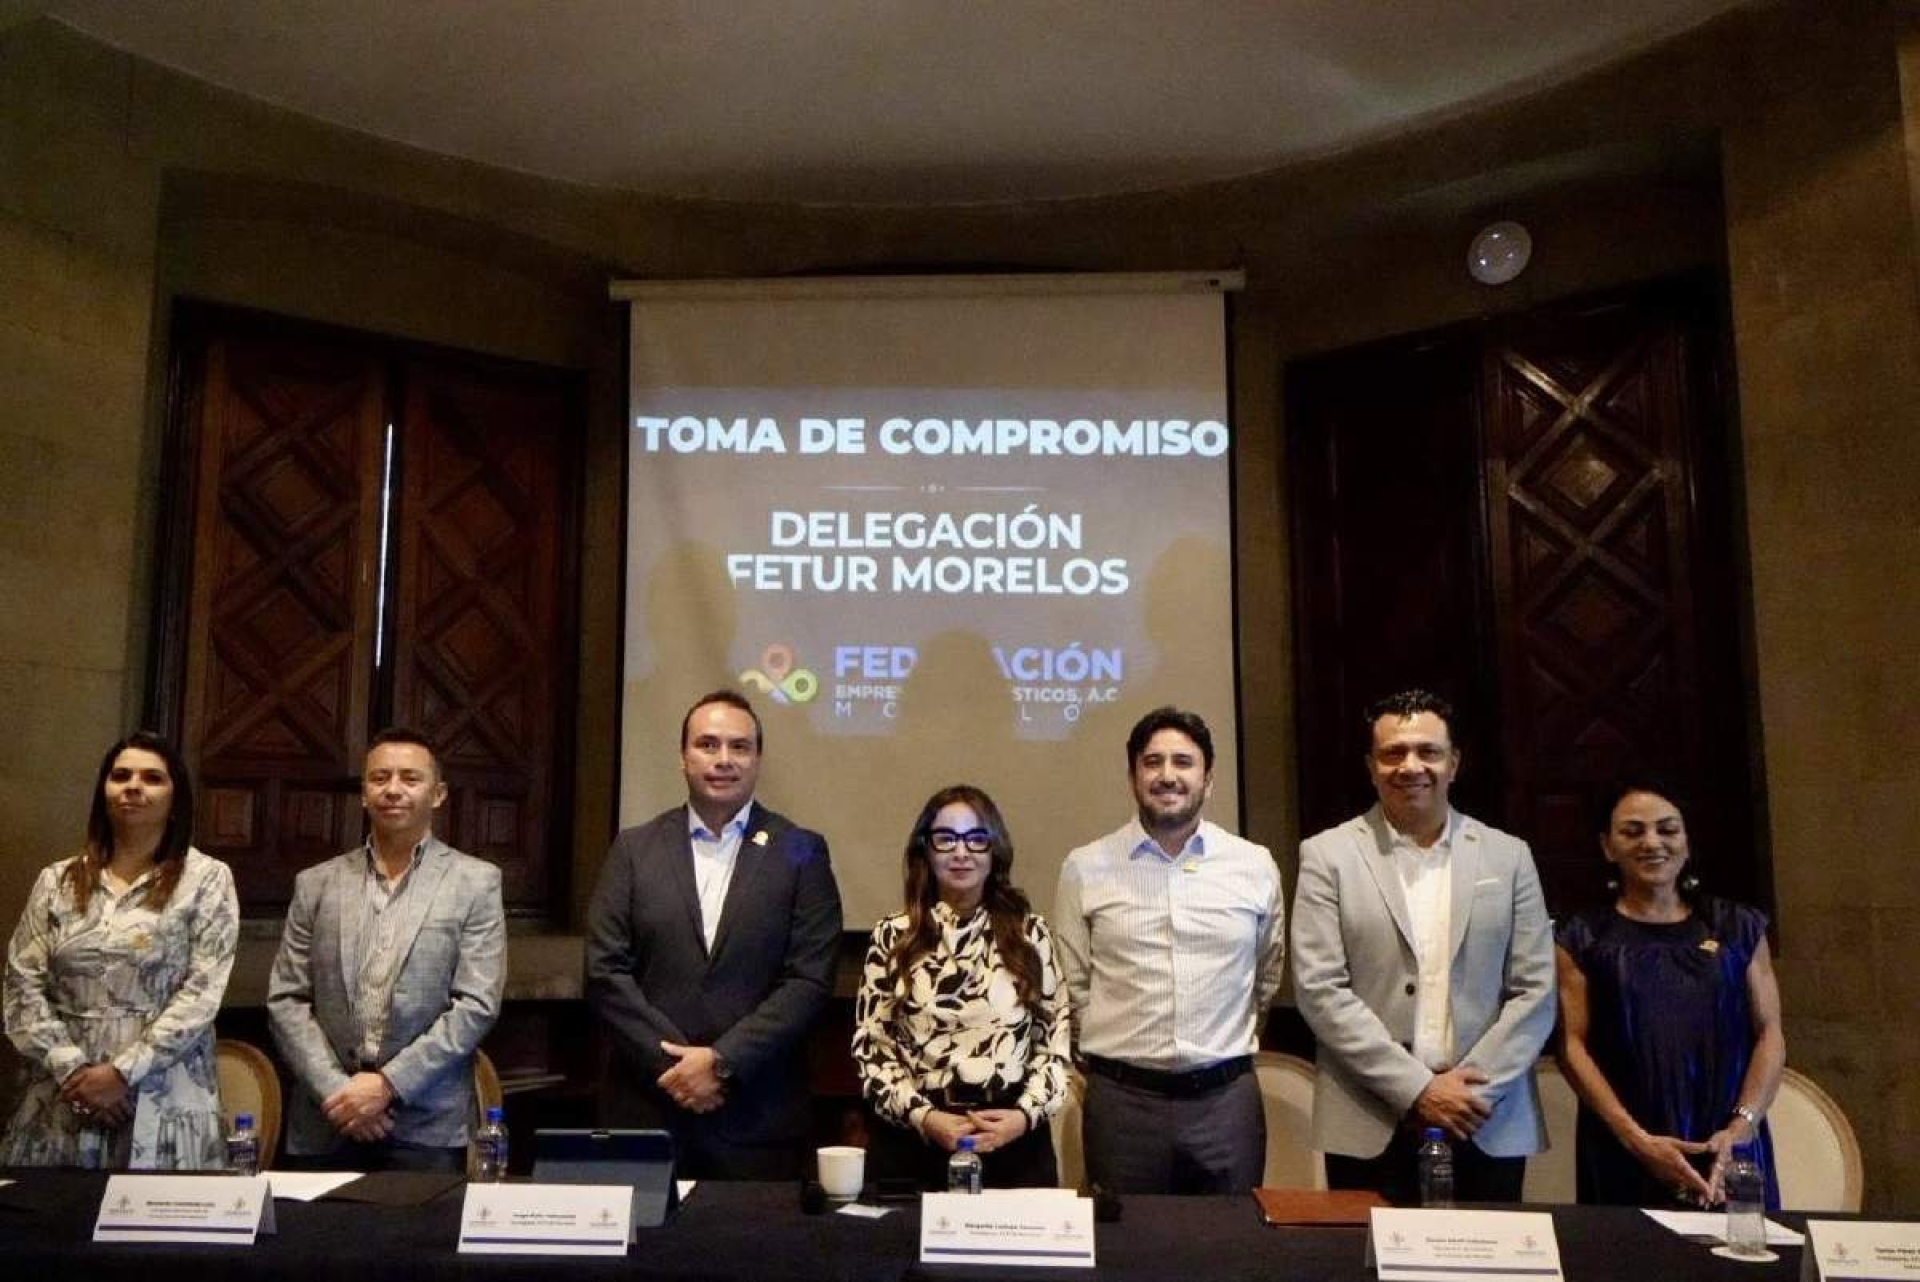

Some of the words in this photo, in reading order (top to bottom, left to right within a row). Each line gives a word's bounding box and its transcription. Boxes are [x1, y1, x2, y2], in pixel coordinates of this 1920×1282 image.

[637, 416, 786, 455] TOMA
[799, 418, 866, 455] DE
[879, 418, 1229, 458] COMPROMISO
[771, 503, 1082, 551] DELEGACIÓN
[727, 553, 878, 592] FETUR
[891, 556, 1130, 595] MORELOS
